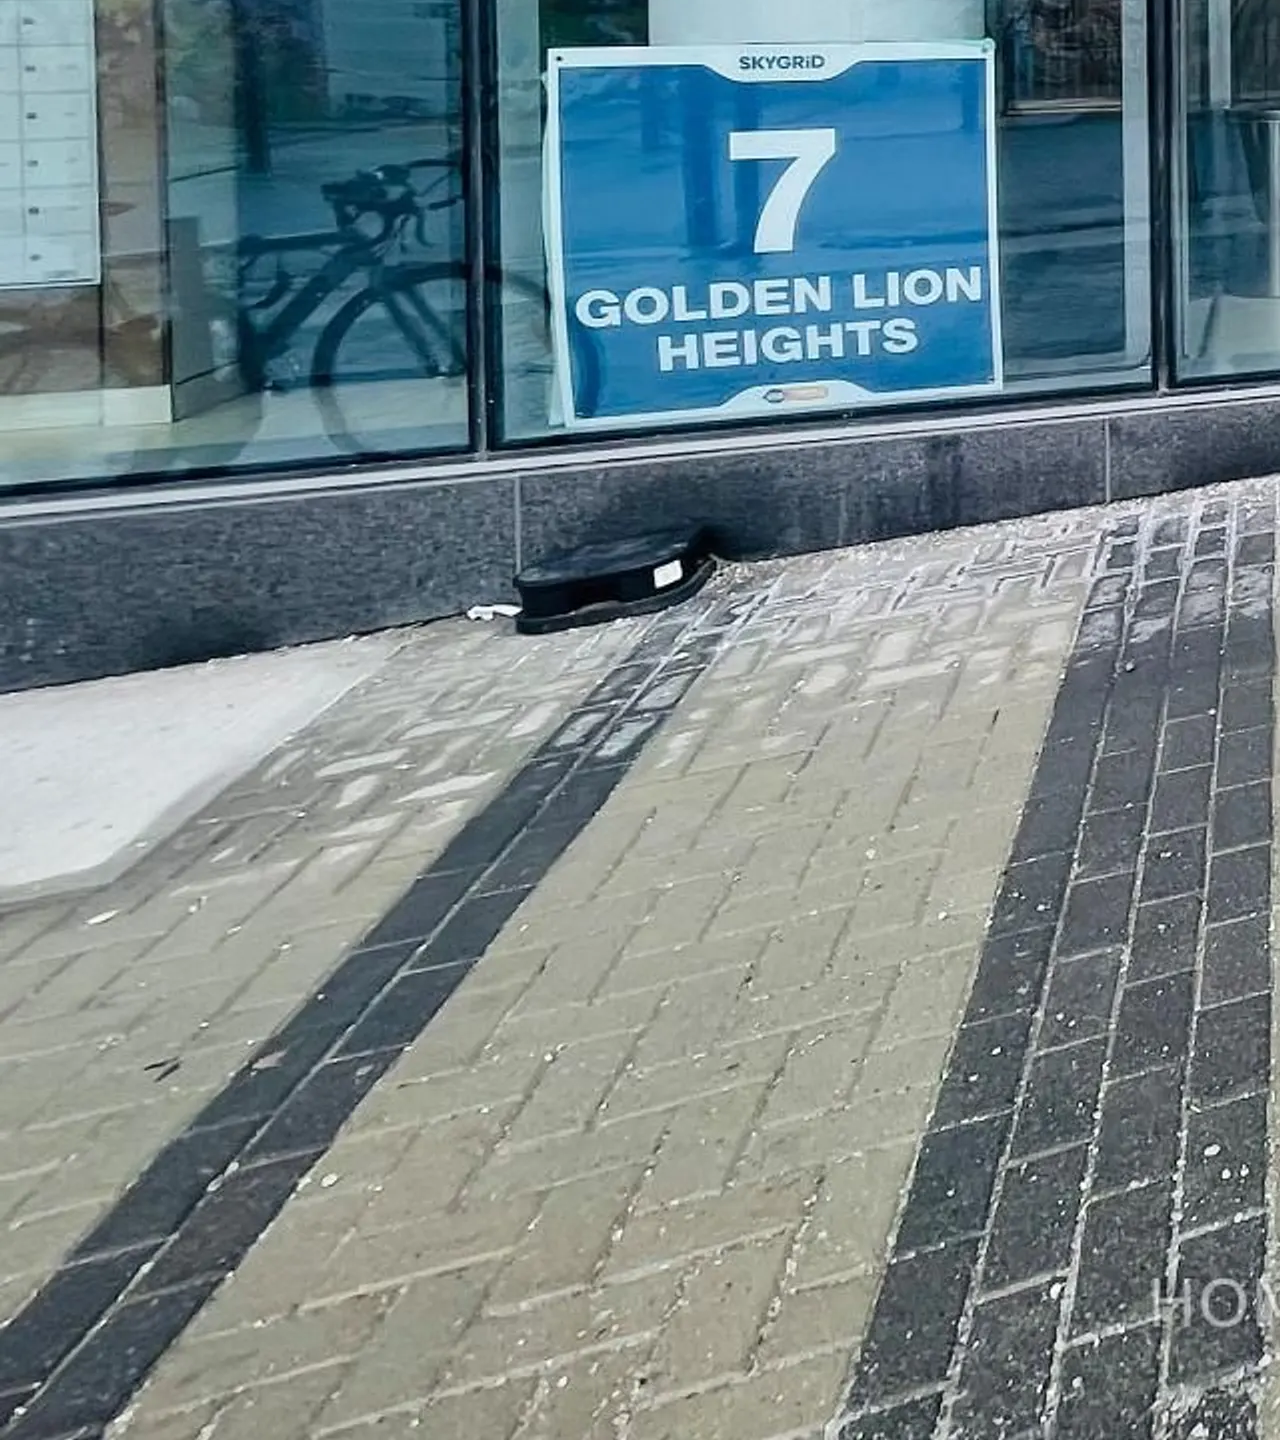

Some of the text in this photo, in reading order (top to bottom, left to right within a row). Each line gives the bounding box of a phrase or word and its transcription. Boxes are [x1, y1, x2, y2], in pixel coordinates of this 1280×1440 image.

[729, 127, 836, 254] 7
[574, 265, 982, 329] GOLDEN LION
[657, 317, 919, 372] HEIGHTS
